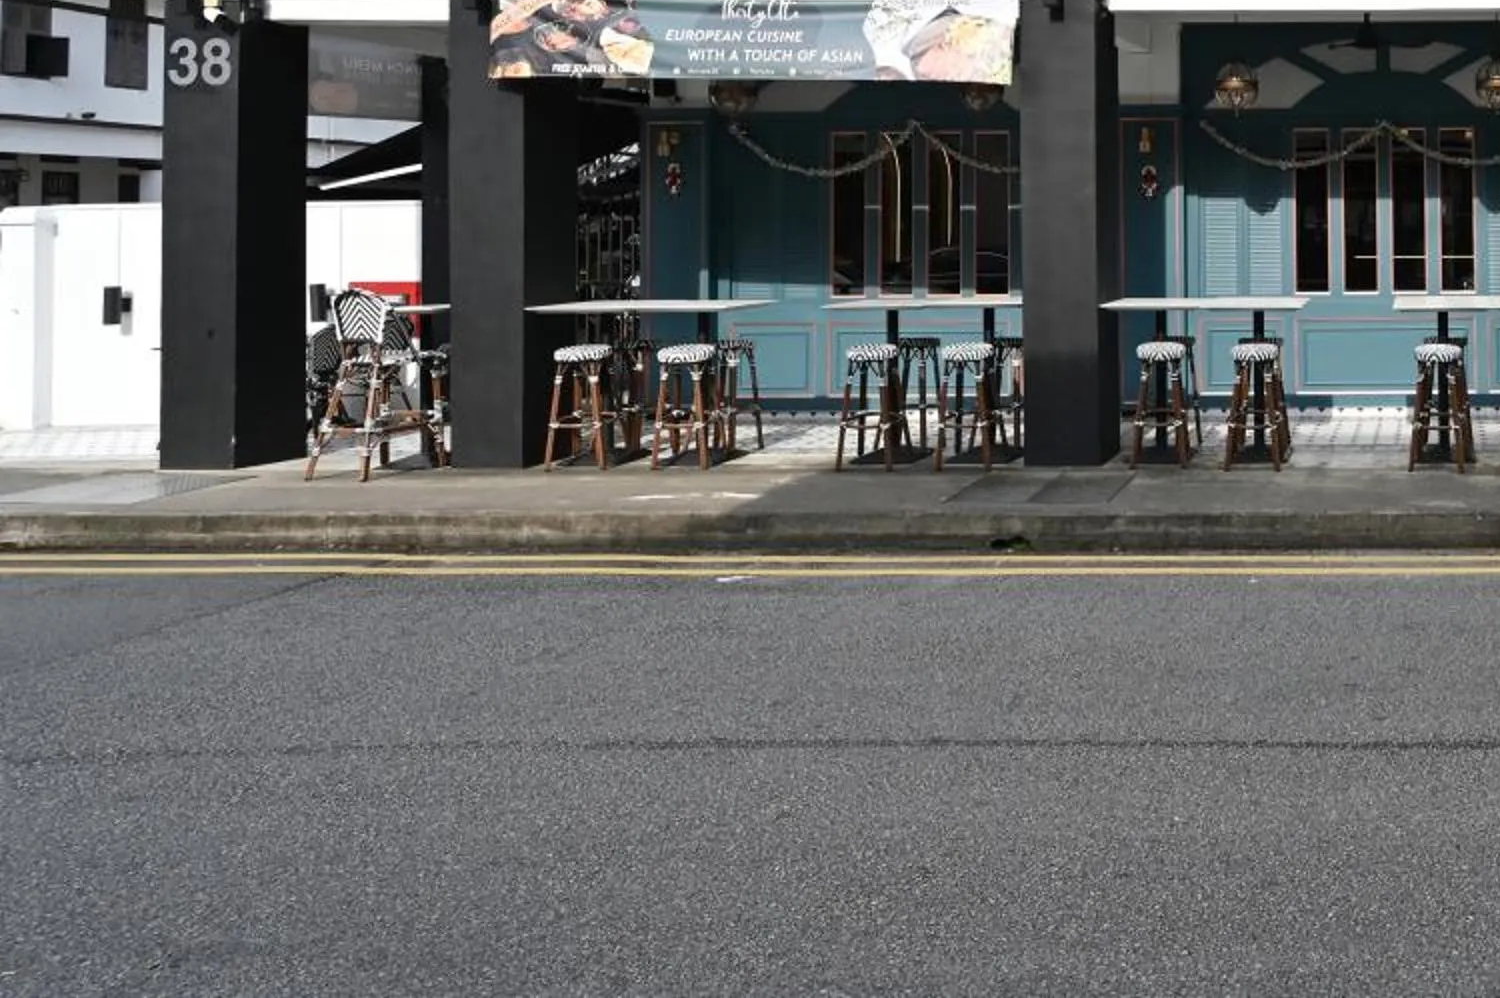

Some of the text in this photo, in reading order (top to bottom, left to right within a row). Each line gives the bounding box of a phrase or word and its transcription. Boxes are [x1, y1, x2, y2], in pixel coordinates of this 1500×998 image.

[665, 28, 804, 43] EUROPEAN CUISINE
[167, 37, 232, 86] 38
[687, 48, 864, 63] WITH A TOUCH OF ASIAN
